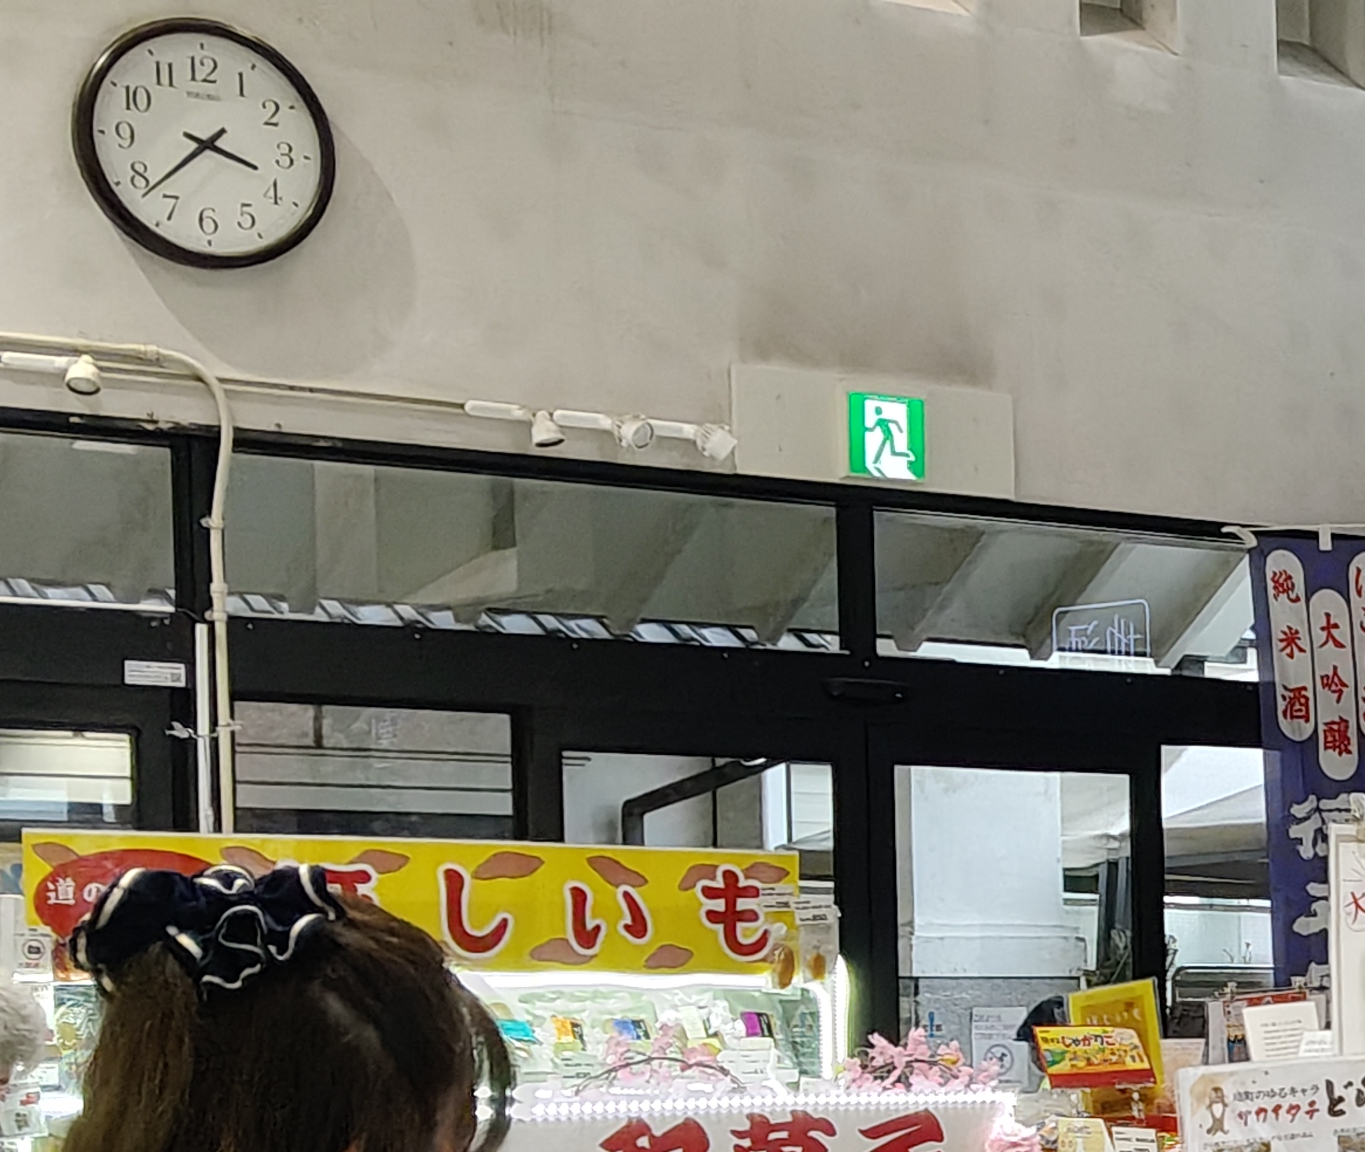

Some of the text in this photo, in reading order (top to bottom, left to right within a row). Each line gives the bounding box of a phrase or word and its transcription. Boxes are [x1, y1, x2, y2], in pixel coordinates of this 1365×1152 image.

[155, 60, 178, 88] 11
[188, 54, 218, 84] 12
[237, 71, 246, 98] 1
[124, 85, 151, 113] 10
[261, 98, 280, 127] 2
[114, 120, 135, 149] 9
[275, 142, 294, 170] 3
[130, 160, 150, 190] 8
[263, 178, 282, 206] 4
[162, 193, 180, 221] 7
[198, 206, 219, 236] 6
[237, 203, 256, 231] 5
[1271, 570, 1311, 724] 純米酒
[1317, 611, 1354, 758] 大吟醸
